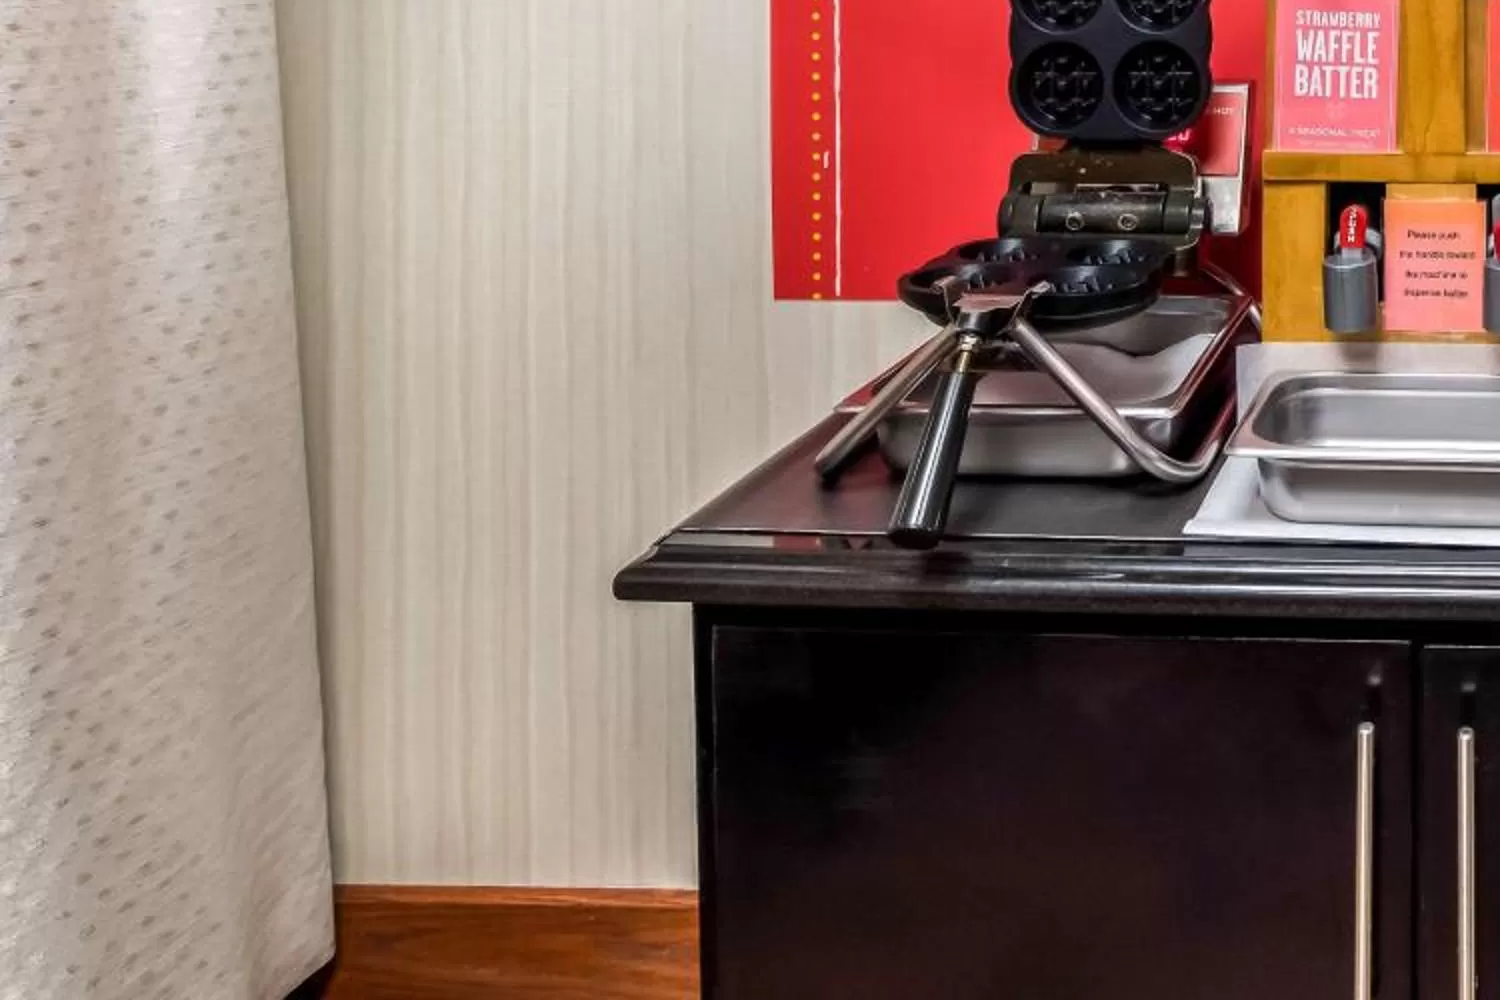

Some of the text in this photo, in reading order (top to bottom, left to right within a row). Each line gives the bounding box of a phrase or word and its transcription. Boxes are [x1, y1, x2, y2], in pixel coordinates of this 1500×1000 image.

[1295, 9, 1381, 29] STRAWBERRY
[1295, 28, 1381, 65] WAFFLE
[1293, 63, 1379, 99] BATTER
[1406, 229, 1436, 240] Please
